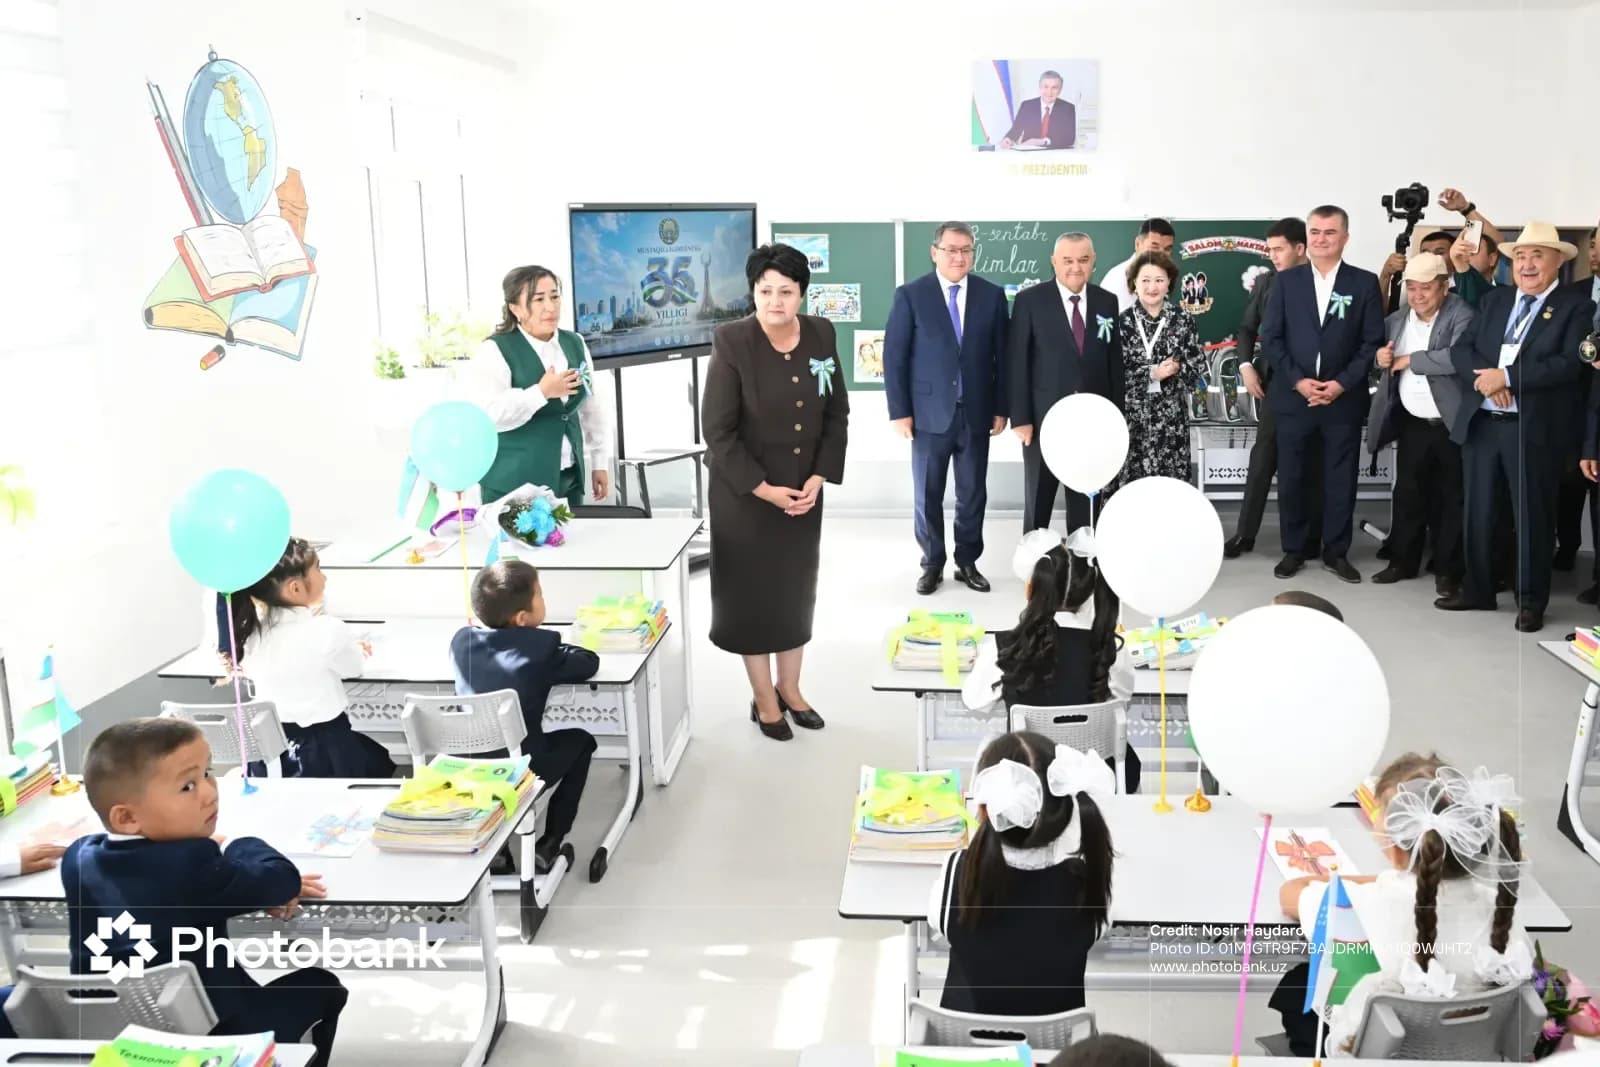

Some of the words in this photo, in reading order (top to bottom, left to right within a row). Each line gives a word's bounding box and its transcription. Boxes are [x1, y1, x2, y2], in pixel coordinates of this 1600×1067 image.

[1188, 241, 1222, 252] SALOM
[641, 256, 698, 308] 35
[656, 308, 688, 319] YILLIGI
